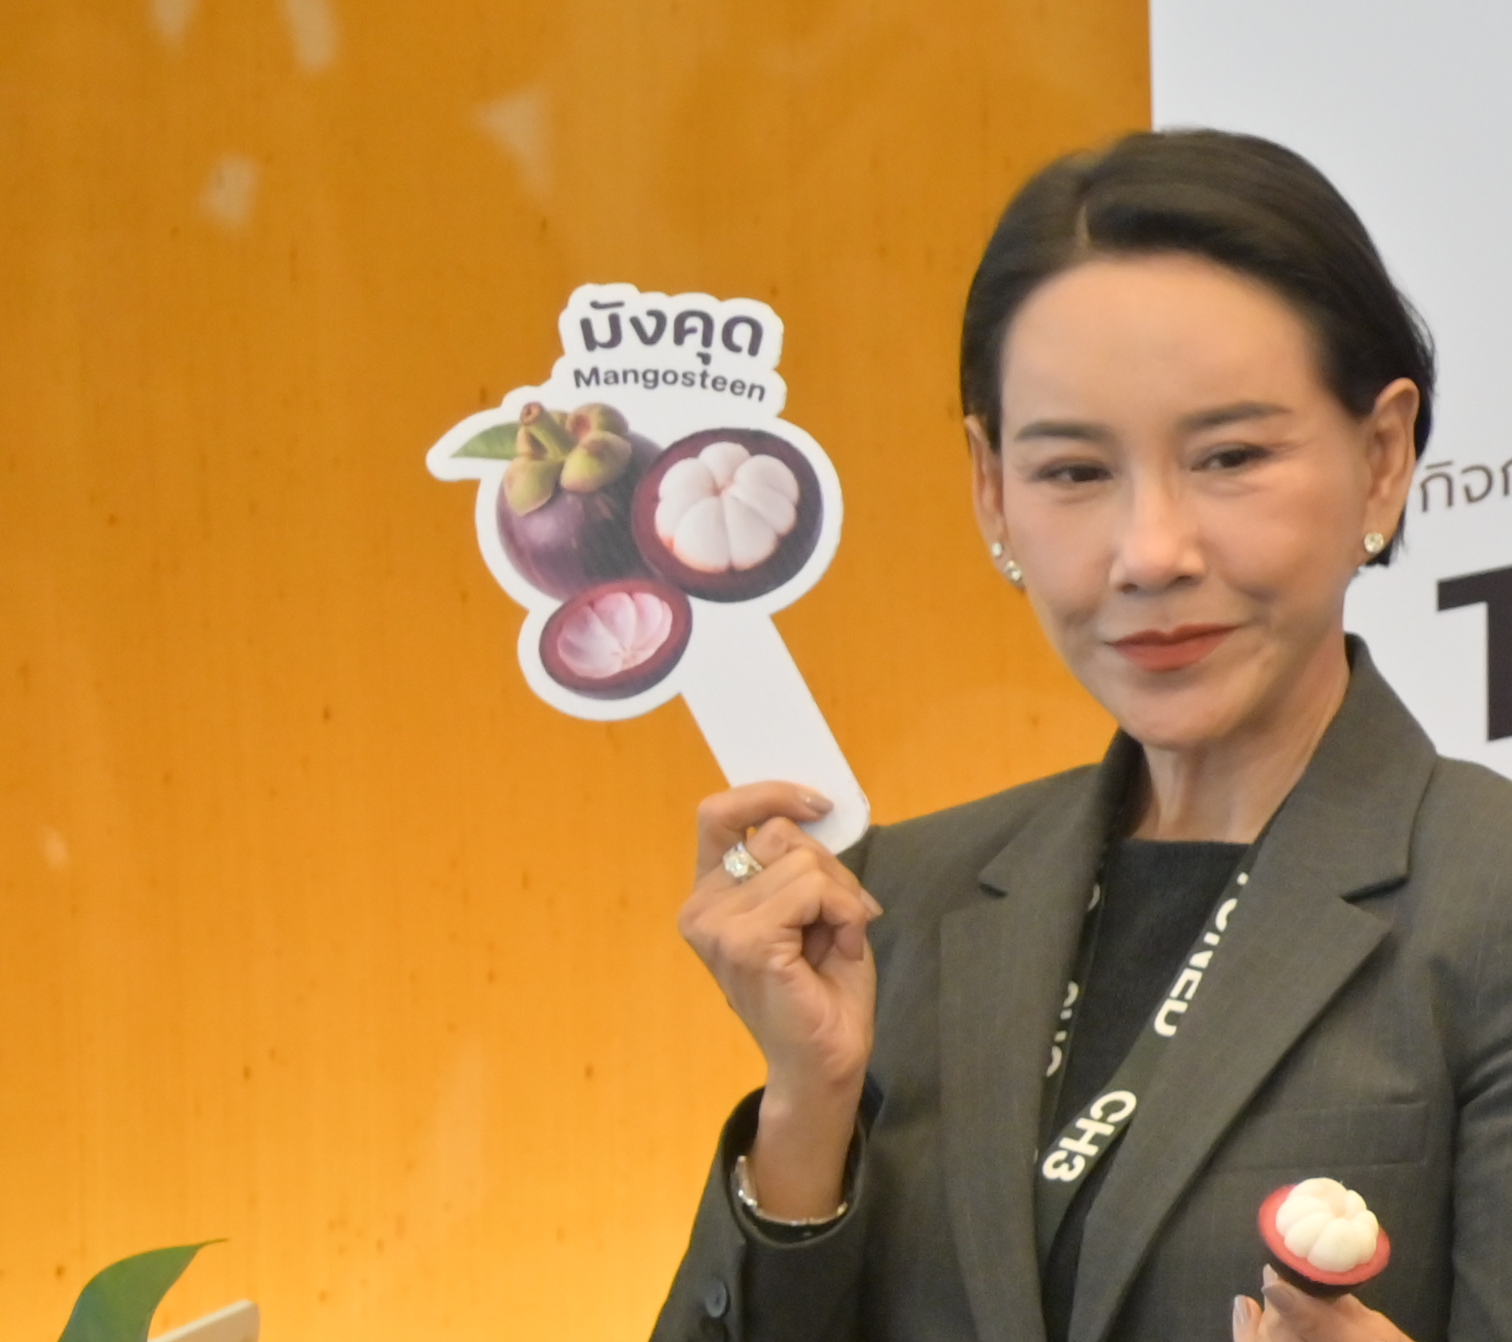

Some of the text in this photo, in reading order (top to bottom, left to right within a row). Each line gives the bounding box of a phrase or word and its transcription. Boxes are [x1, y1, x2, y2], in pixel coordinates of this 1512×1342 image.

[579, 300, 765, 366] มังคุด
[573, 366, 766, 403] Mangosteen
[1042, 1089, 1138, 1183] CH3
